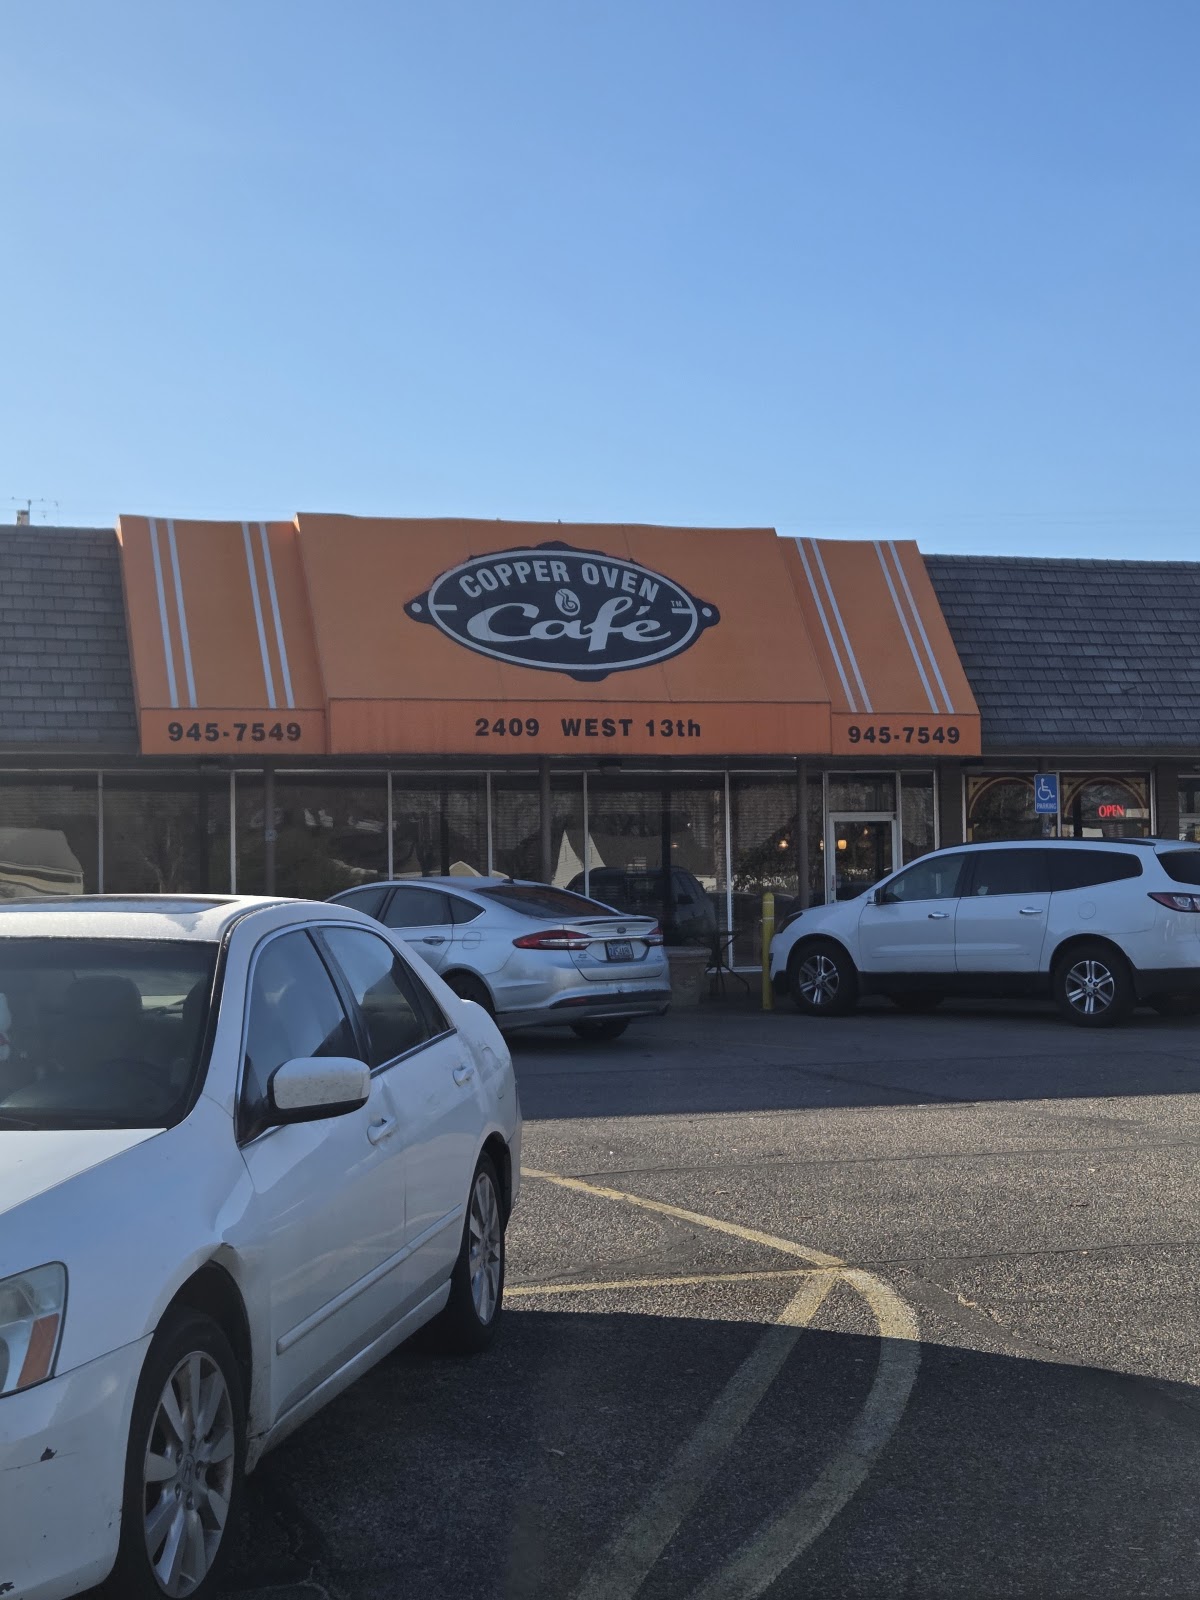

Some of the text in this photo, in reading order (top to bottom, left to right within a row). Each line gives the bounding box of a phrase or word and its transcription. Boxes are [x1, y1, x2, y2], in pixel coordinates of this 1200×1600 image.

[459, 560, 659, 603] COPPER OVEN
[466, 596, 671, 652] Café
[168, 722, 302, 742] 945-7549
[475, 718, 702, 738] 2409 WEST 13th
[848, 726, 961, 744] 945-7549
[1036, 802, 1057, 811] PARKING
[1098, 804, 1125, 818] OPEN
